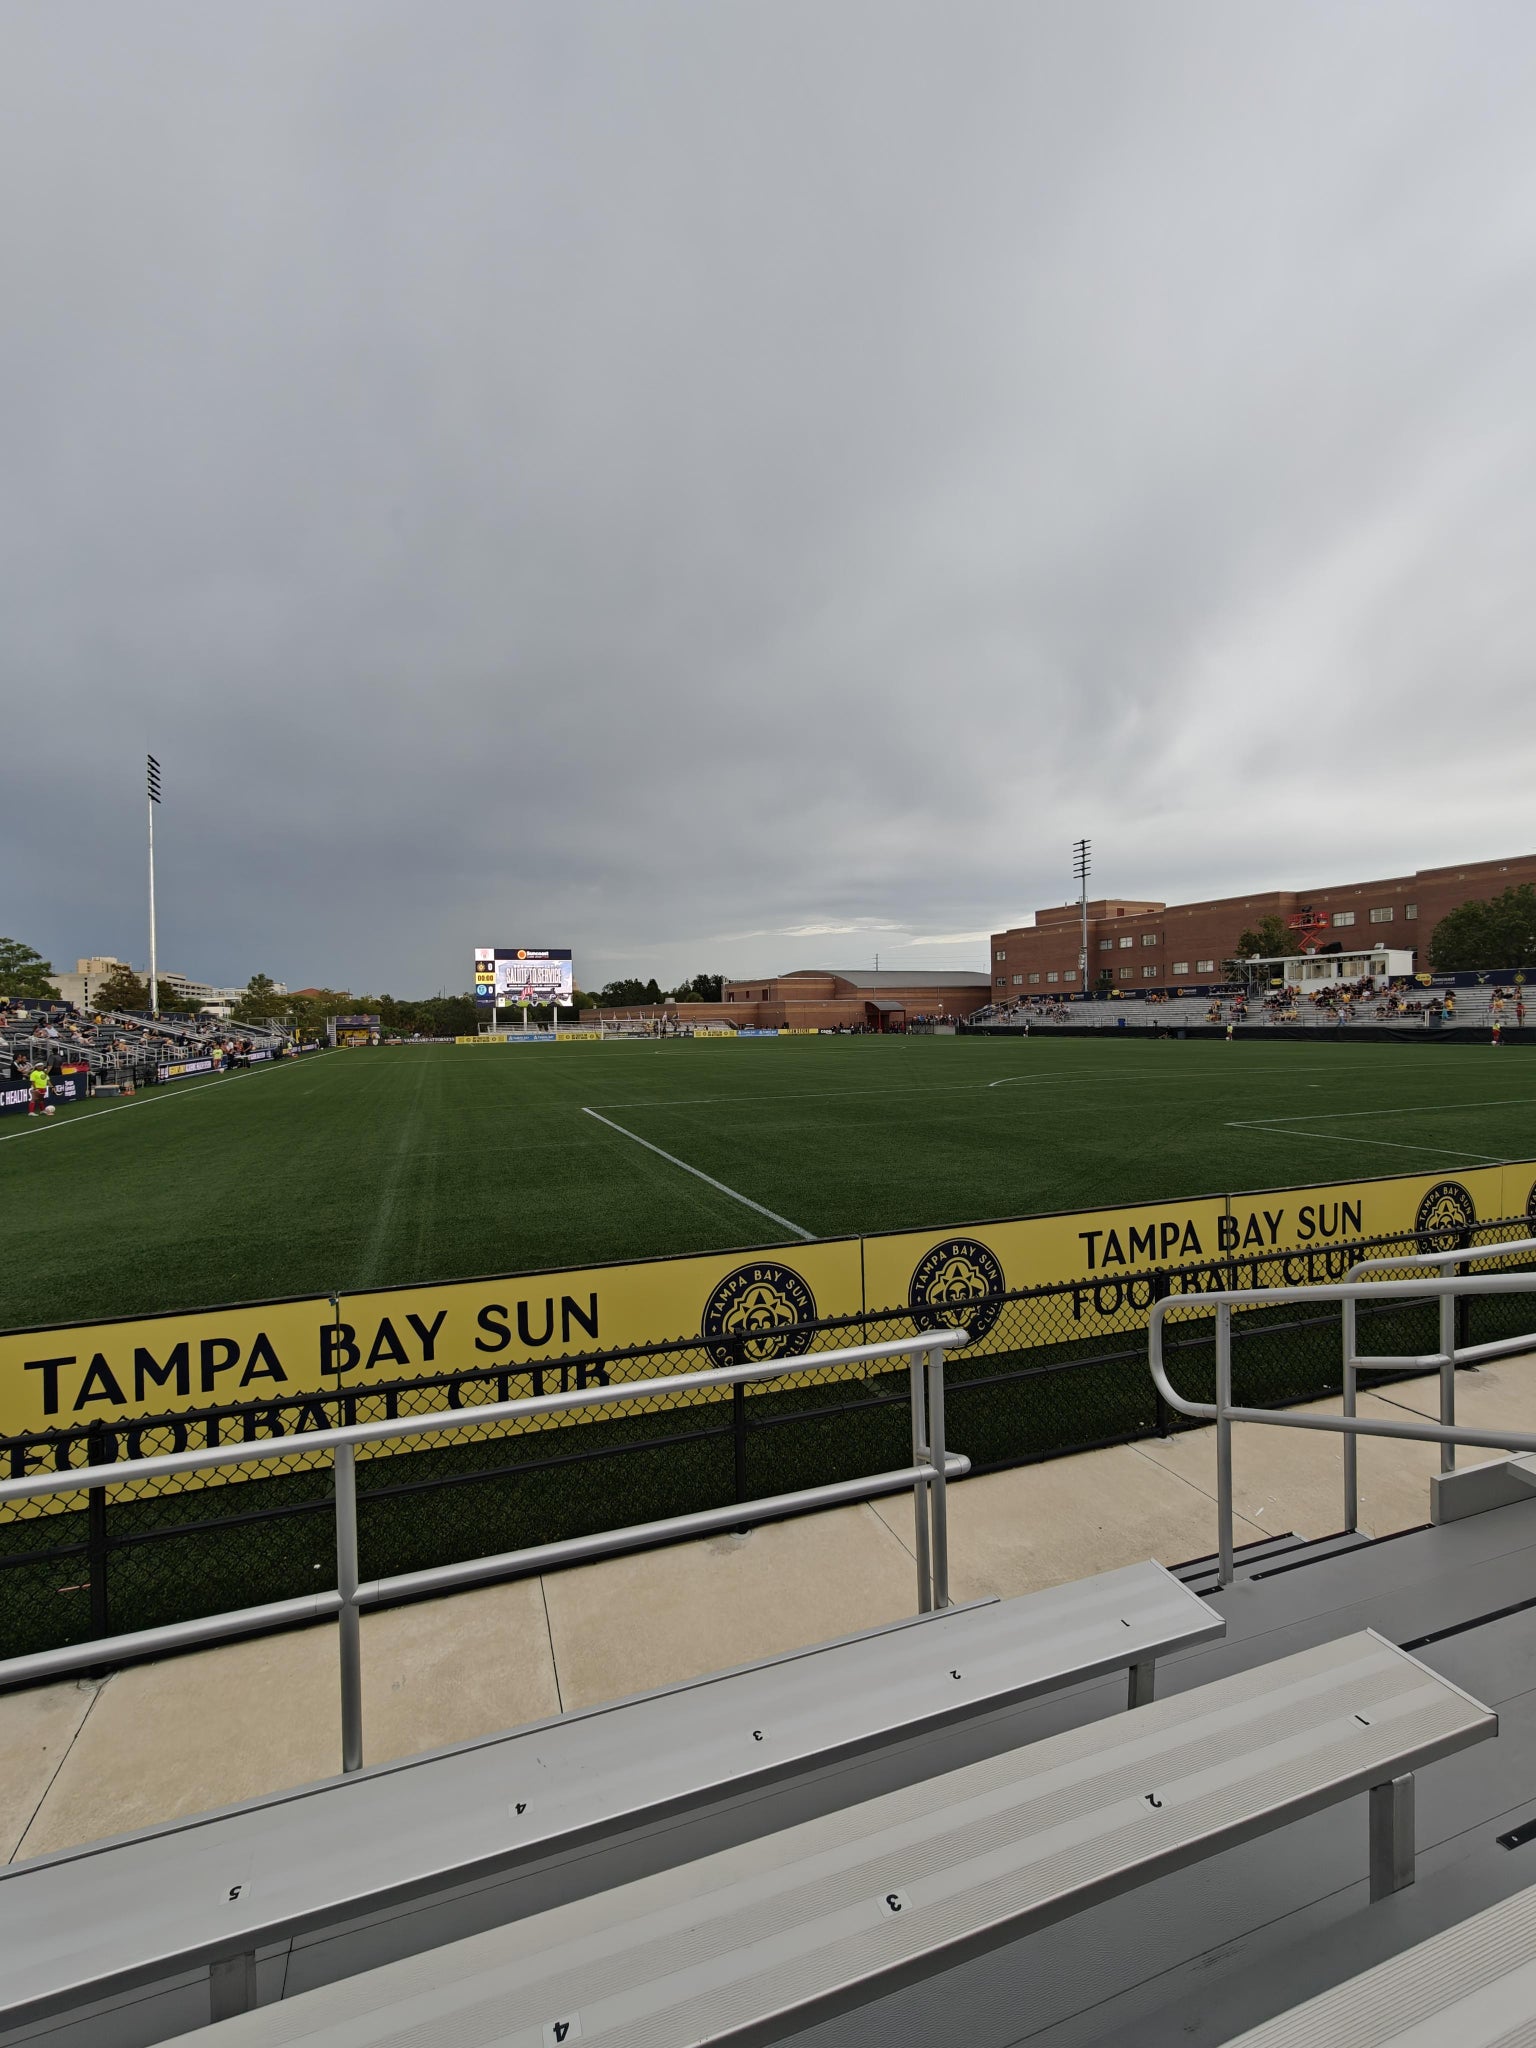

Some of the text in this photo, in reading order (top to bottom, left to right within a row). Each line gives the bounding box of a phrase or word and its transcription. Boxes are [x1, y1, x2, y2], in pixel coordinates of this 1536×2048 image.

[488, 963, 493, 971] 0
[506, 967, 562, 983] SALUTE TO SERVICE
[6, 1088, 28, 1106] HEALTH
[1420, 1186, 1472, 1221] TAMPA BAY SUN
[1079, 1200, 1362, 1269] TAMPA BAY SUN
[915, 1245, 998, 1291] TAMPA BAY SUN
[710, 1269, 808, 1319] TAMPA BAY SUN
[1073, 1264, 1270, 1320] FOOBAL
[24, 1292, 599, 1415] TAMPA BAY SUN
[949, 1669, 961, 1680] 2
[752, 1730, 763, 1741] 3
[514, 1802, 527, 1815] 4
[1144, 1793, 1162, 1808] 2
[228, 1885, 242, 1902] 5
[885, 1893, 902, 1912] 3
[552, 2021, 570, 2043] 4
